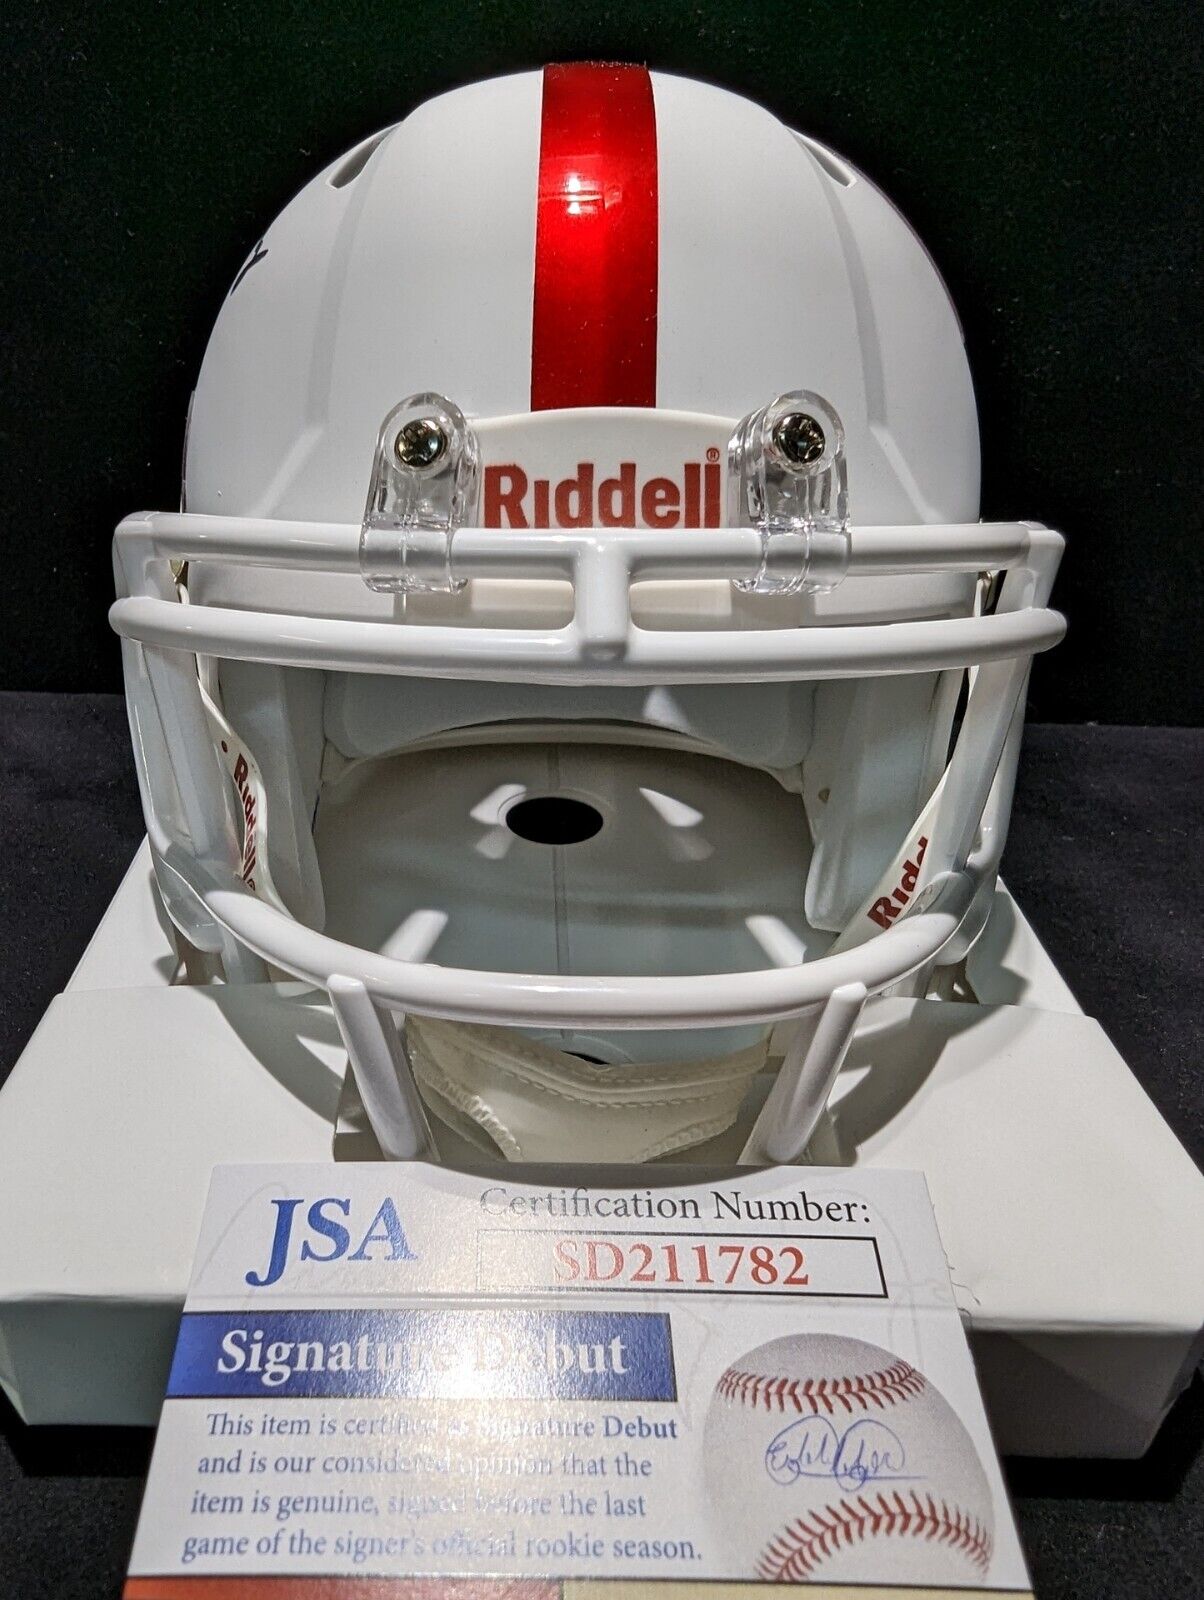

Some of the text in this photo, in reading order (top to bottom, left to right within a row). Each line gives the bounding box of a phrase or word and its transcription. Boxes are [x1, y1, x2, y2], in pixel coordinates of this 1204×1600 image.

[484, 463, 721, 529] Riddell
[480, 1187, 871, 1223] Certification Number:
[245, 1197, 418, 1287] JSA
[553, 1240, 810, 1286] SD211782
[217, 1328, 631, 1387] Signature Debut
[207, 1413, 253, 1435] This
[261, 1413, 310, 1435] item
[319, 1413, 337, 1435] is
[603, 1415, 678, 1439] Debut
[198, 1449, 652, 1482] and is our considered opinion that the
[191, 1490, 243, 1514] item
[251, 1490, 270, 1514] is
[276, 1490, 380, 1521] genuine,
[388, 1488, 466, 1521] signed
[560, 1490, 597, 1516] the
[605, 1491, 647, 1517] last
[181, 1529, 702, 1563] game of the signer's official rookie season.
